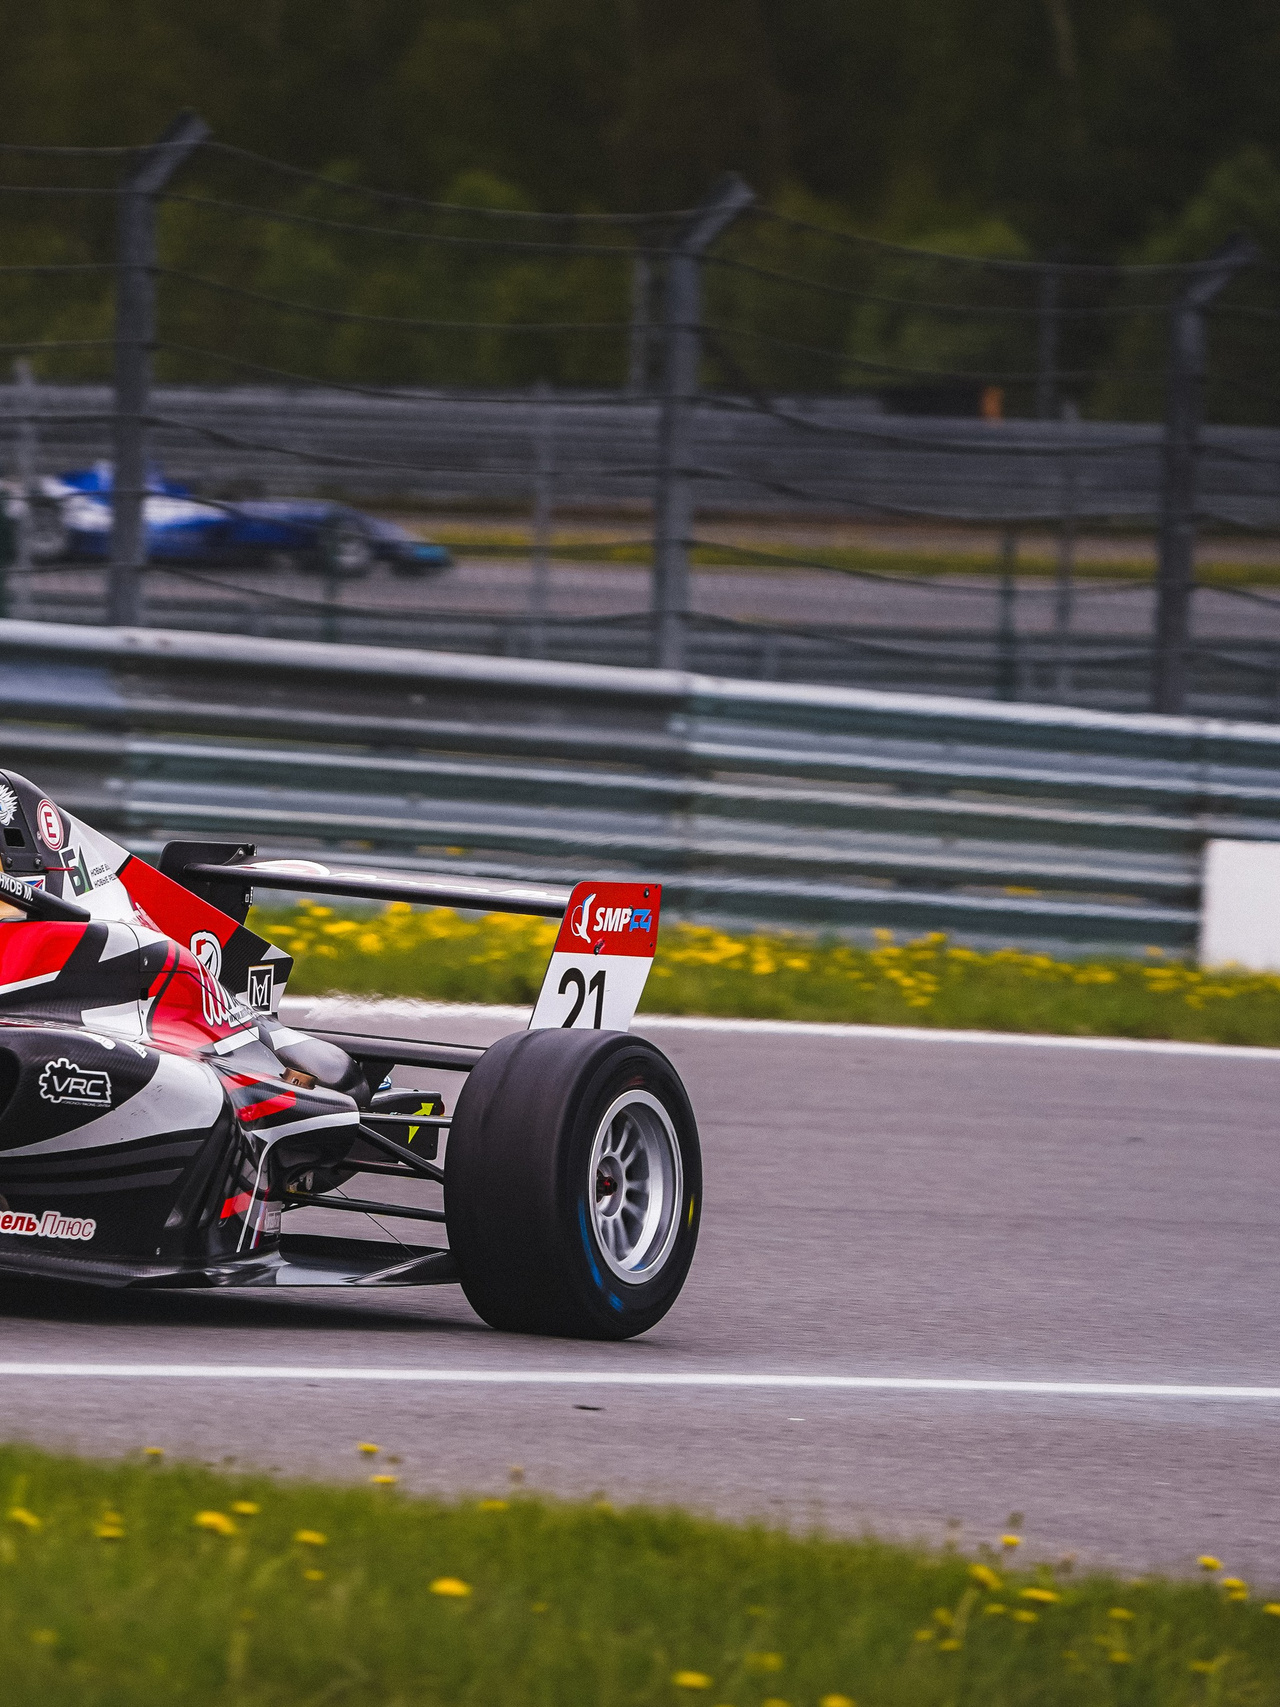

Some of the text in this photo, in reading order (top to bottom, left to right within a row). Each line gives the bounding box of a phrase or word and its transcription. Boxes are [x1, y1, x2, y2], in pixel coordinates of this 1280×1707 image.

[43, 811, 57, 838] E
[251, 974, 271, 1007] M
[558, 967, 606, 1029] 21
[52, 1075, 104, 1096] VRC
[40, 1213, 94, 1238] Плюс
